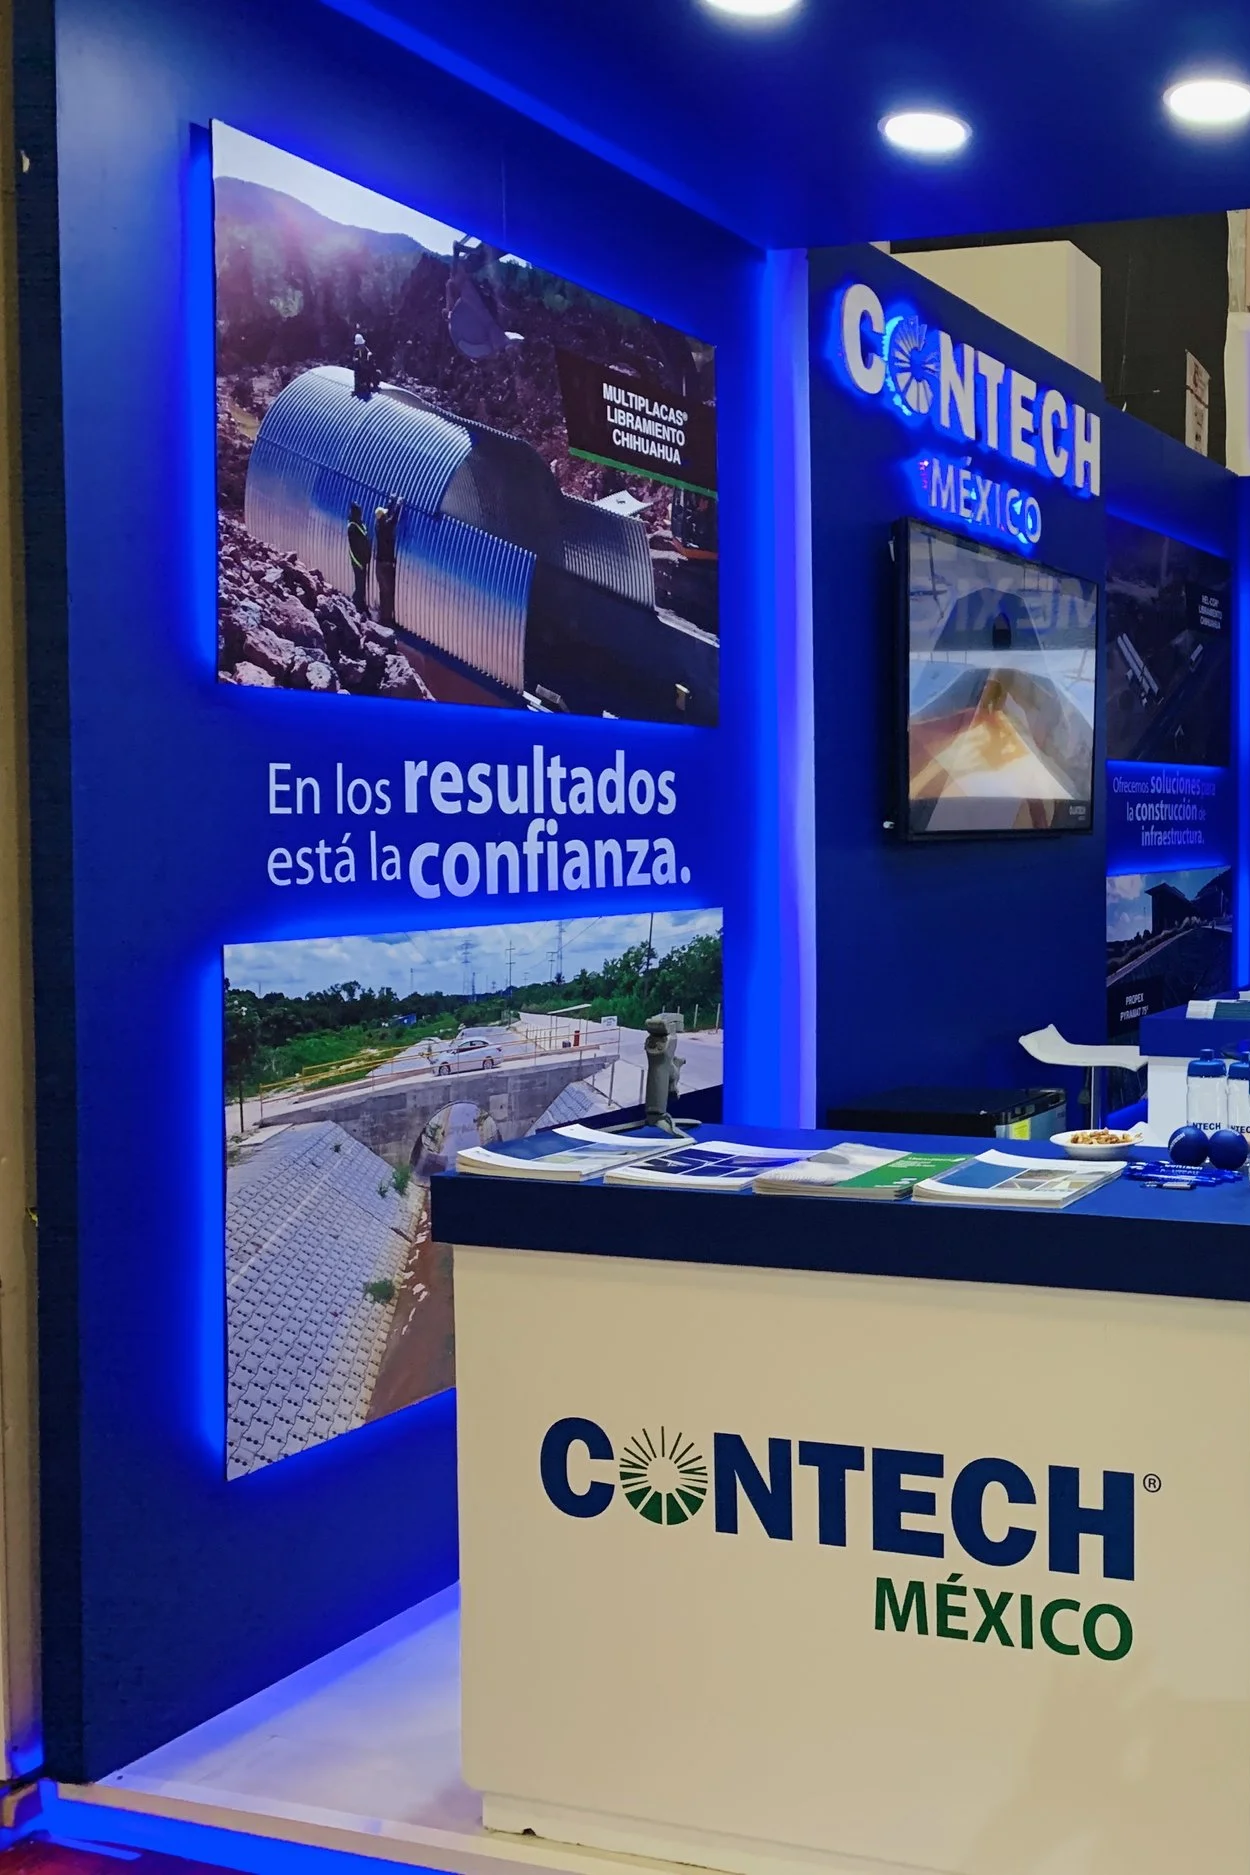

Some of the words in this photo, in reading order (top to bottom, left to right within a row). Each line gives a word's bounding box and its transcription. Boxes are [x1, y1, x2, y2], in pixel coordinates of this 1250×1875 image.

[840, 283, 1100, 496] CONTECH
[606, 405, 685, 446] LIBRAMIENTO
[612, 428, 682, 465] CHIHUAHUA
[929, 457, 1042, 544] MÉXICO
[268, 762, 320, 814] En
[336, 762, 391, 815] los
[403, 744, 677, 815] resultados
[1112, 776, 1149, 794] Ofrecemos
[1150, 768, 1200, 796] soluciones
[1126, 801, 1134, 821] la
[1135, 797, 1198, 821] construcción
[1141, 824, 1205, 847] infraestructura.
[267, 832, 356, 886] está
[369, 830, 402, 881] la
[408, 817, 692, 899] confianza.
[873, 1572, 1134, 1661] MÉXICO
